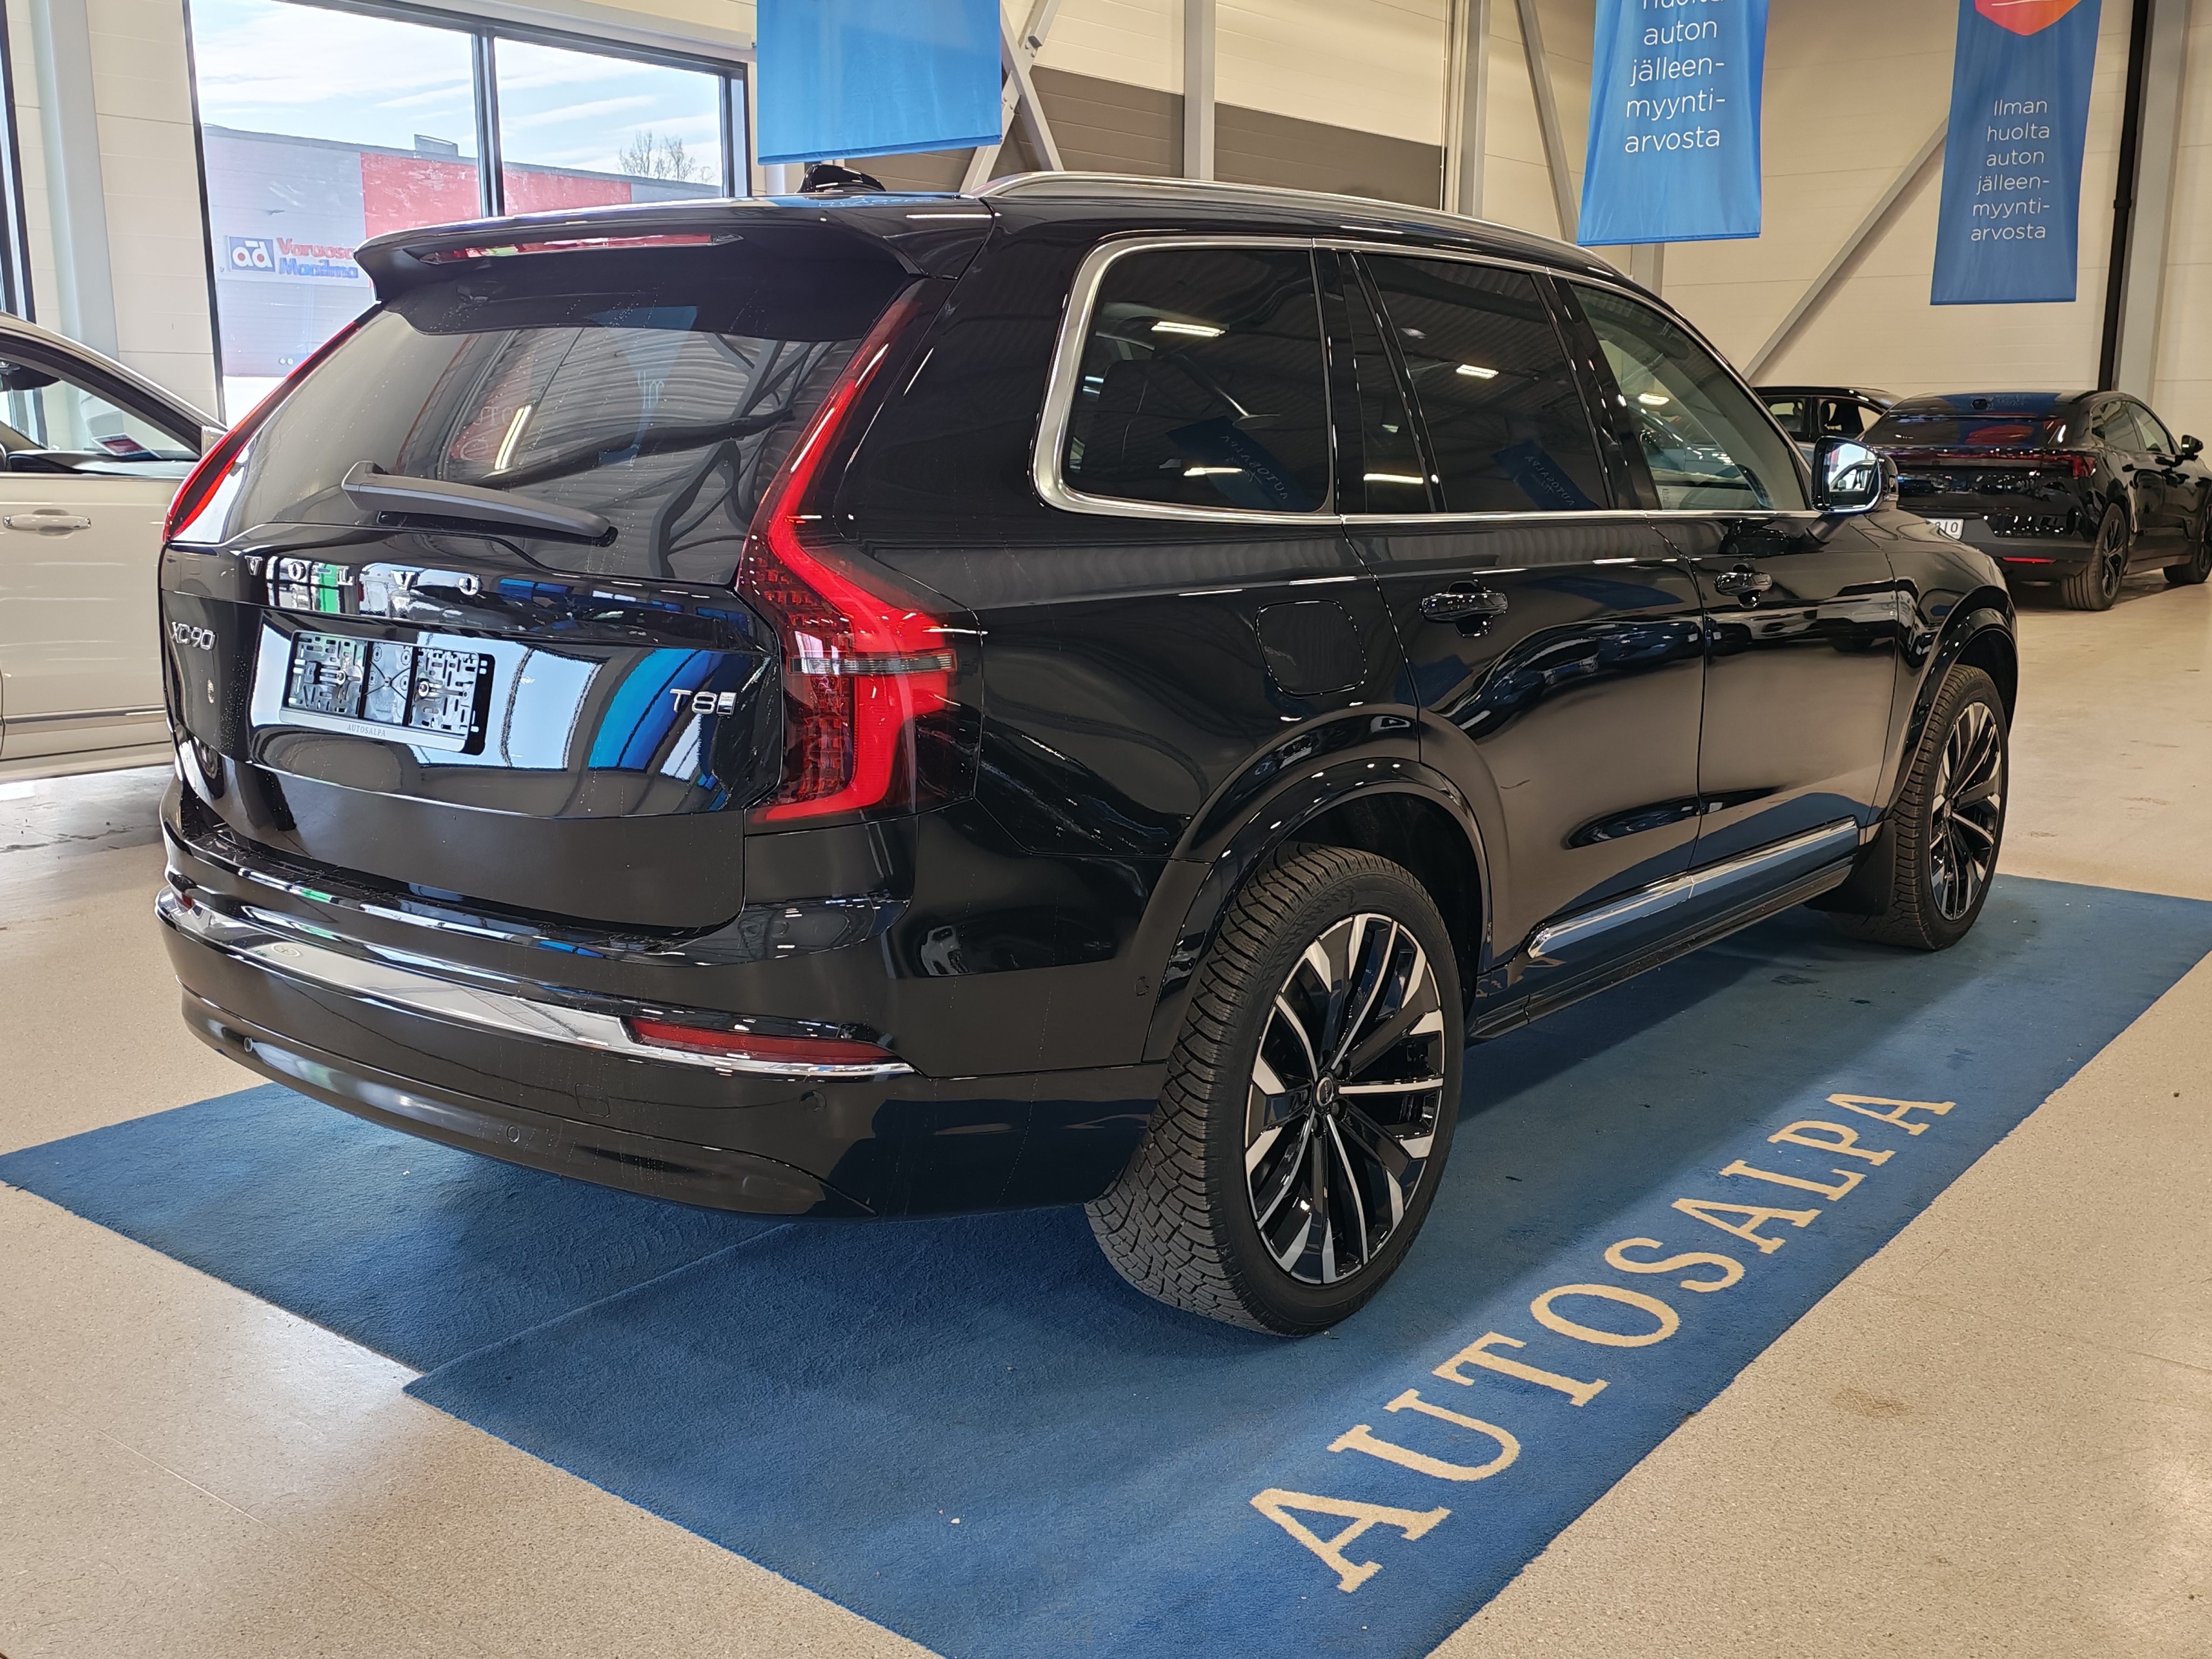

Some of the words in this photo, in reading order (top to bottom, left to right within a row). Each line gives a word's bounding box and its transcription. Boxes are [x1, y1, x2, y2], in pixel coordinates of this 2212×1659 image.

[1643, 20, 1717, 45] auton
[1630, 57, 1725, 86] jälleen-
[1626, 88, 1725, 121] myynti-
[1994, 98, 2047, 116] Ilman
[1624, 126, 1721, 153] arvosta
[1986, 122, 2050, 143] huolta
[1986, 149, 2045, 167] auton
[1976, 174, 2050, 195] jälleen-
[1972, 197, 2050, 219] myynti-
[1971, 223, 2046, 241] arvosta
[245, 555, 482, 595] VOLVO
[171, 622, 216, 650] XC90
[669, 689, 718, 714] T8
[347, 724, 386, 737] AUTOSALPA
[1250, 1094, 1956, 1592] AUTOSALPA
